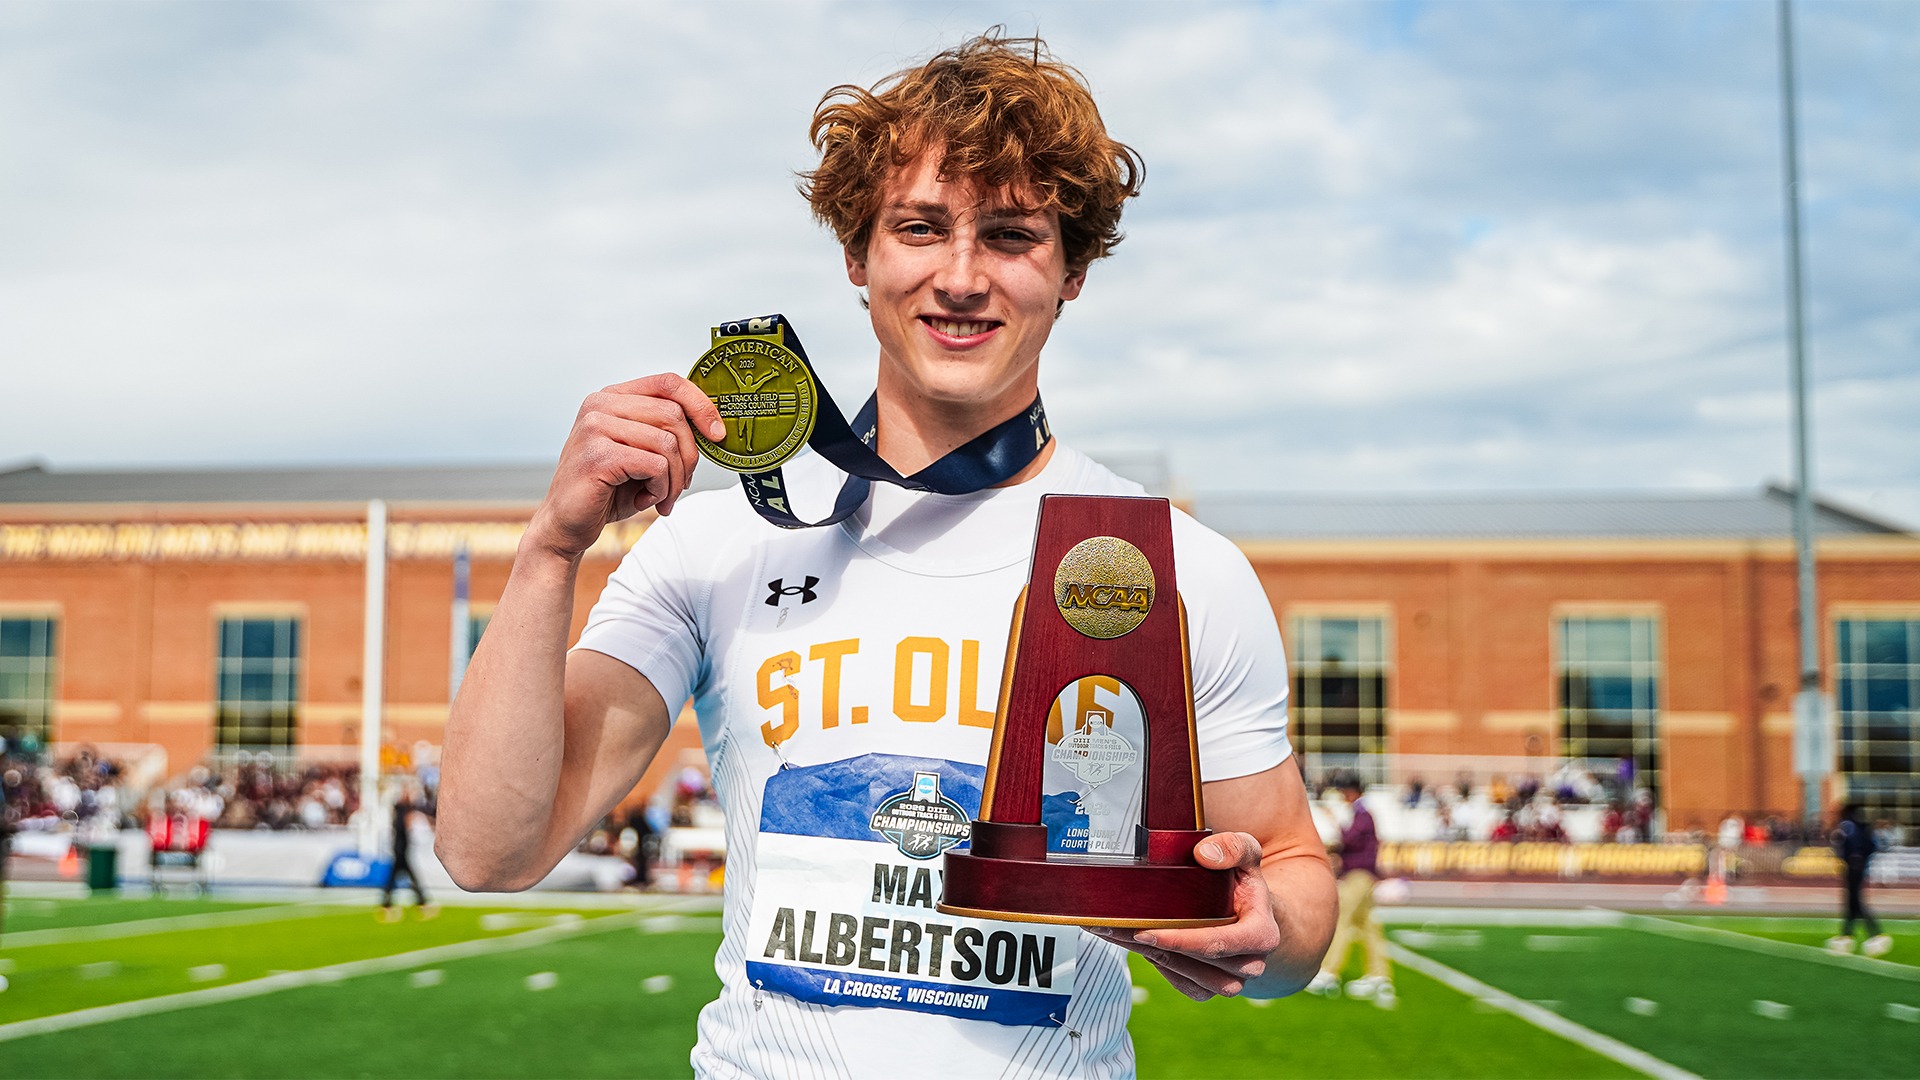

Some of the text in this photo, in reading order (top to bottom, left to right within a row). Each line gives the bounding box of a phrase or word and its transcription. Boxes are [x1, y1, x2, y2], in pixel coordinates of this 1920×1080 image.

[699, 341, 798, 377] ALL-AMERICAN
[739, 359, 755, 369] 2026
[728, 402, 747, 410] CROSS
[747, 402, 777, 410] COUNTRY
[730, 394, 752, 403] TRACK
[753, 394, 760, 402] &
[760, 393, 778, 402] FIELD
[733, 450, 780, 465] OUTDOOR
[779, 426, 804, 449] TRACK
[801, 387, 809, 416] FIELD
[1062, 582, 1149, 613] NCAA
[756, 638, 869, 749] ST.
[1053, 749, 1136, 761] CHAMPIONSHIPS
[891, 809, 916, 818] OUTDOOR
[916, 811, 933, 819] TRACK
[938, 813, 954, 821] FIELD
[873, 815, 970, 837] CHAMPIONSHIPS
[1066, 828, 1116, 839] LONG JUMP
[1060, 839, 1121, 850] FOURTH PLACE
[763, 907, 1056, 989] ALBERTSON
[823, 978, 989, 1011] LA CROSSE, WISCONSIN
